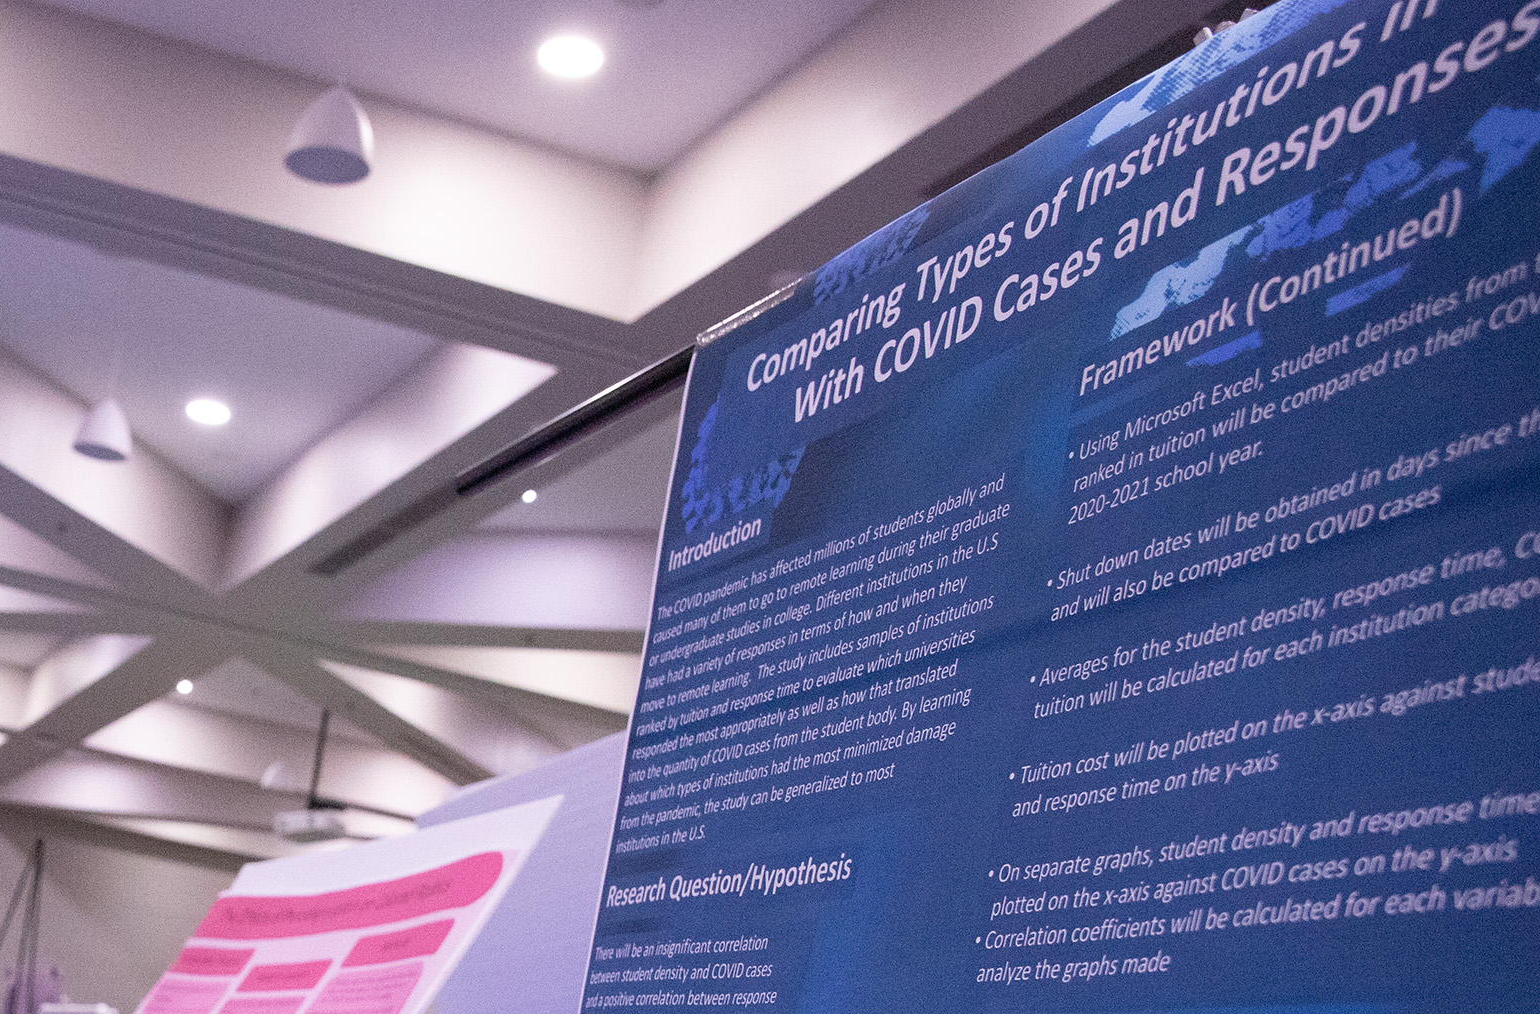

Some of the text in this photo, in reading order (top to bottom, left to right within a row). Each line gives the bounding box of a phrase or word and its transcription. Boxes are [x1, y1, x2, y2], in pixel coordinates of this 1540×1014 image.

[745, 281, 907, 392] Comparing
[916, 219, 1015, 303] Types
[1023, 179, 1073, 240] of
[1075, 20, 1367, 213] Institutions
[793, 0, 1540, 423] With COVID Cases and Responses
[1078, 189, 1462, 396] Framework (Continued)
[1066, 439, 1263, 525] 2020-2021 school year.
[656, 471, 1006, 620] The COVID pandemic has affected millions of students globally and
[667, 517, 762, 571] Introduction
[1049, 484, 1441, 622] and will also be compared to COVID cases
[639, 594, 995, 713] move to remote learning. The study includes samples of institutions
[1032, 693, 1085, 719] tuition
[1088, 679, 1118, 707] will
[1119, 677, 1144, 699] be
[1145, 649, 1239, 693] calculated
[1240, 645, 1271, 669] for
[1272, 629, 1324, 661] each
[1326, 600, 1444, 647] institution
[627, 687, 973, 783] into the quantity of COVID cases from the student body. By learning
[1010, 749, 1280, 817] and response time on the y-axis
[605, 851, 853, 907] Research Question/Hypothesis
[989, 835, 1517, 921] plotted on the x-axis against COVID cases on the y-axis
[588, 961, 774, 985] between student density and COVID cases
[975, 948, 1172, 986] analyze the graphs made
